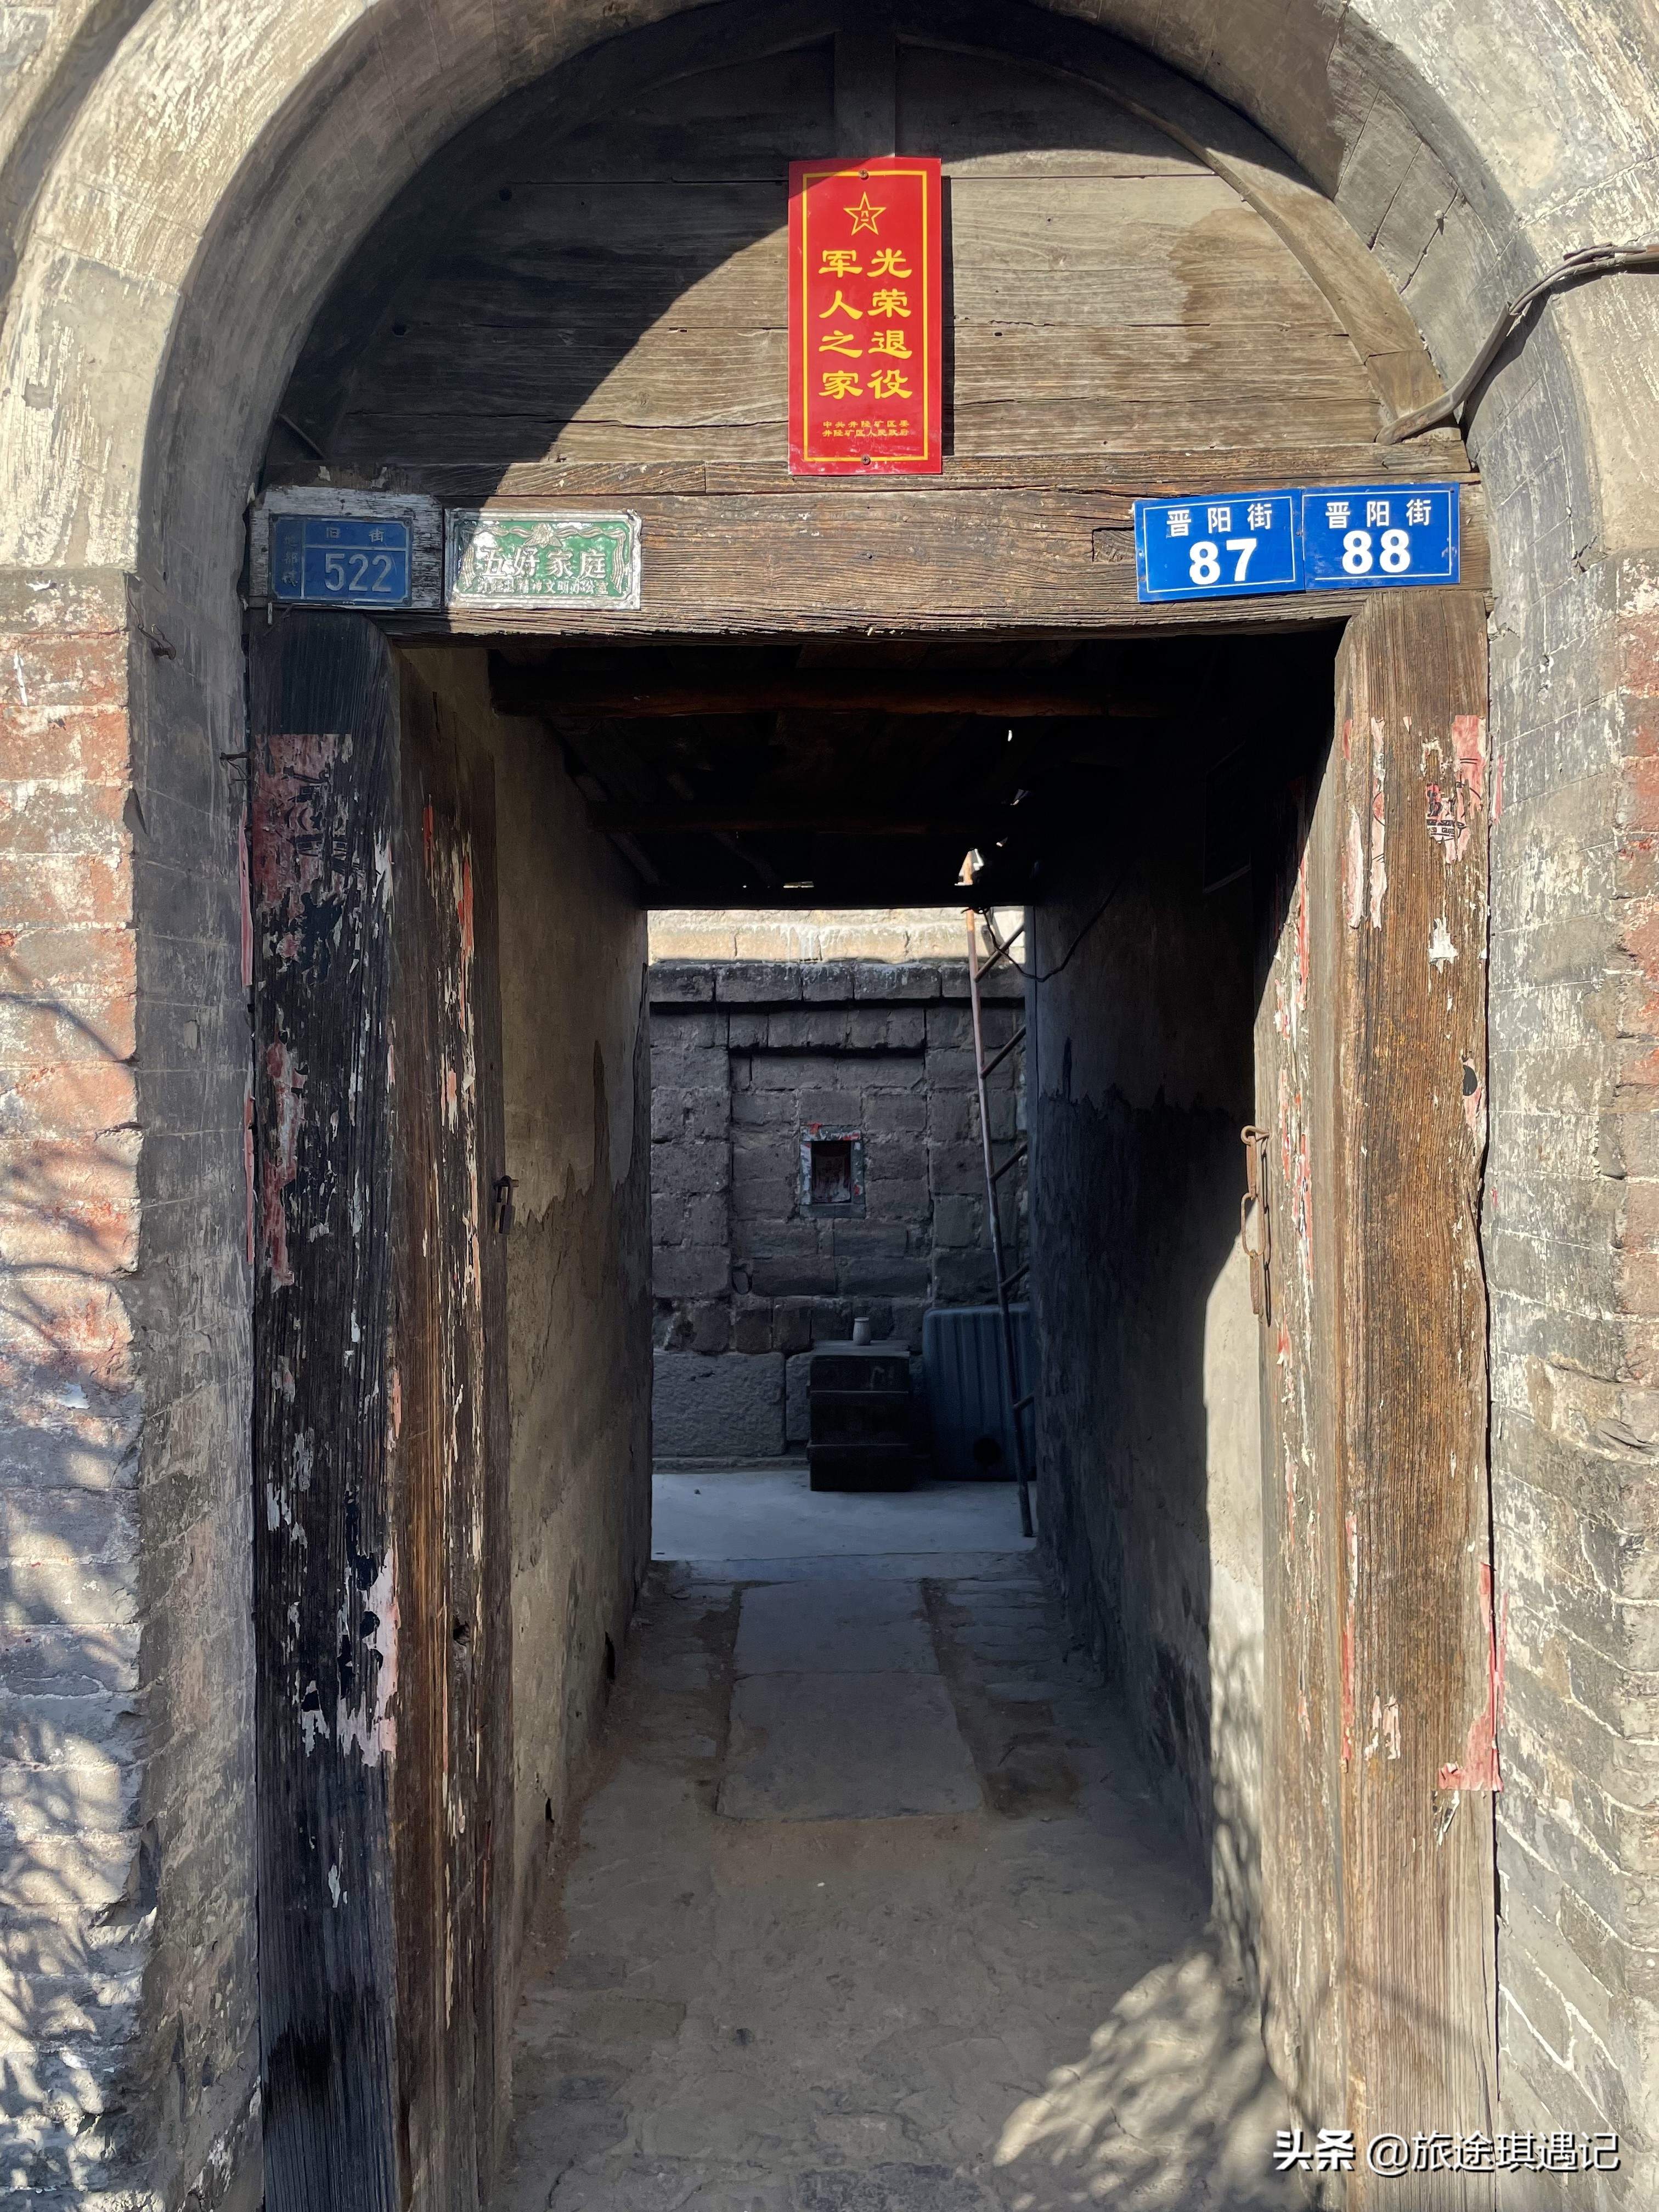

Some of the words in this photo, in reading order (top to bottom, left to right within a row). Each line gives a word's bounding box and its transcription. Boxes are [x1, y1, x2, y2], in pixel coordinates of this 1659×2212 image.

[819, 250, 863, 399] 军人之家
[867, 248, 912, 399] 光荣退役
[822, 429, 910, 437] 井陉矿区人民政府
[1166, 503, 1273, 537] 晋阳街
[1326, 499, 1431, 529] 晋阳街
[481, 547, 607, 579] 五好家庭
[1189, 538, 1257, 585] 87
[1342, 529, 1410, 574] 88
[324, 553, 392, 593] 522
